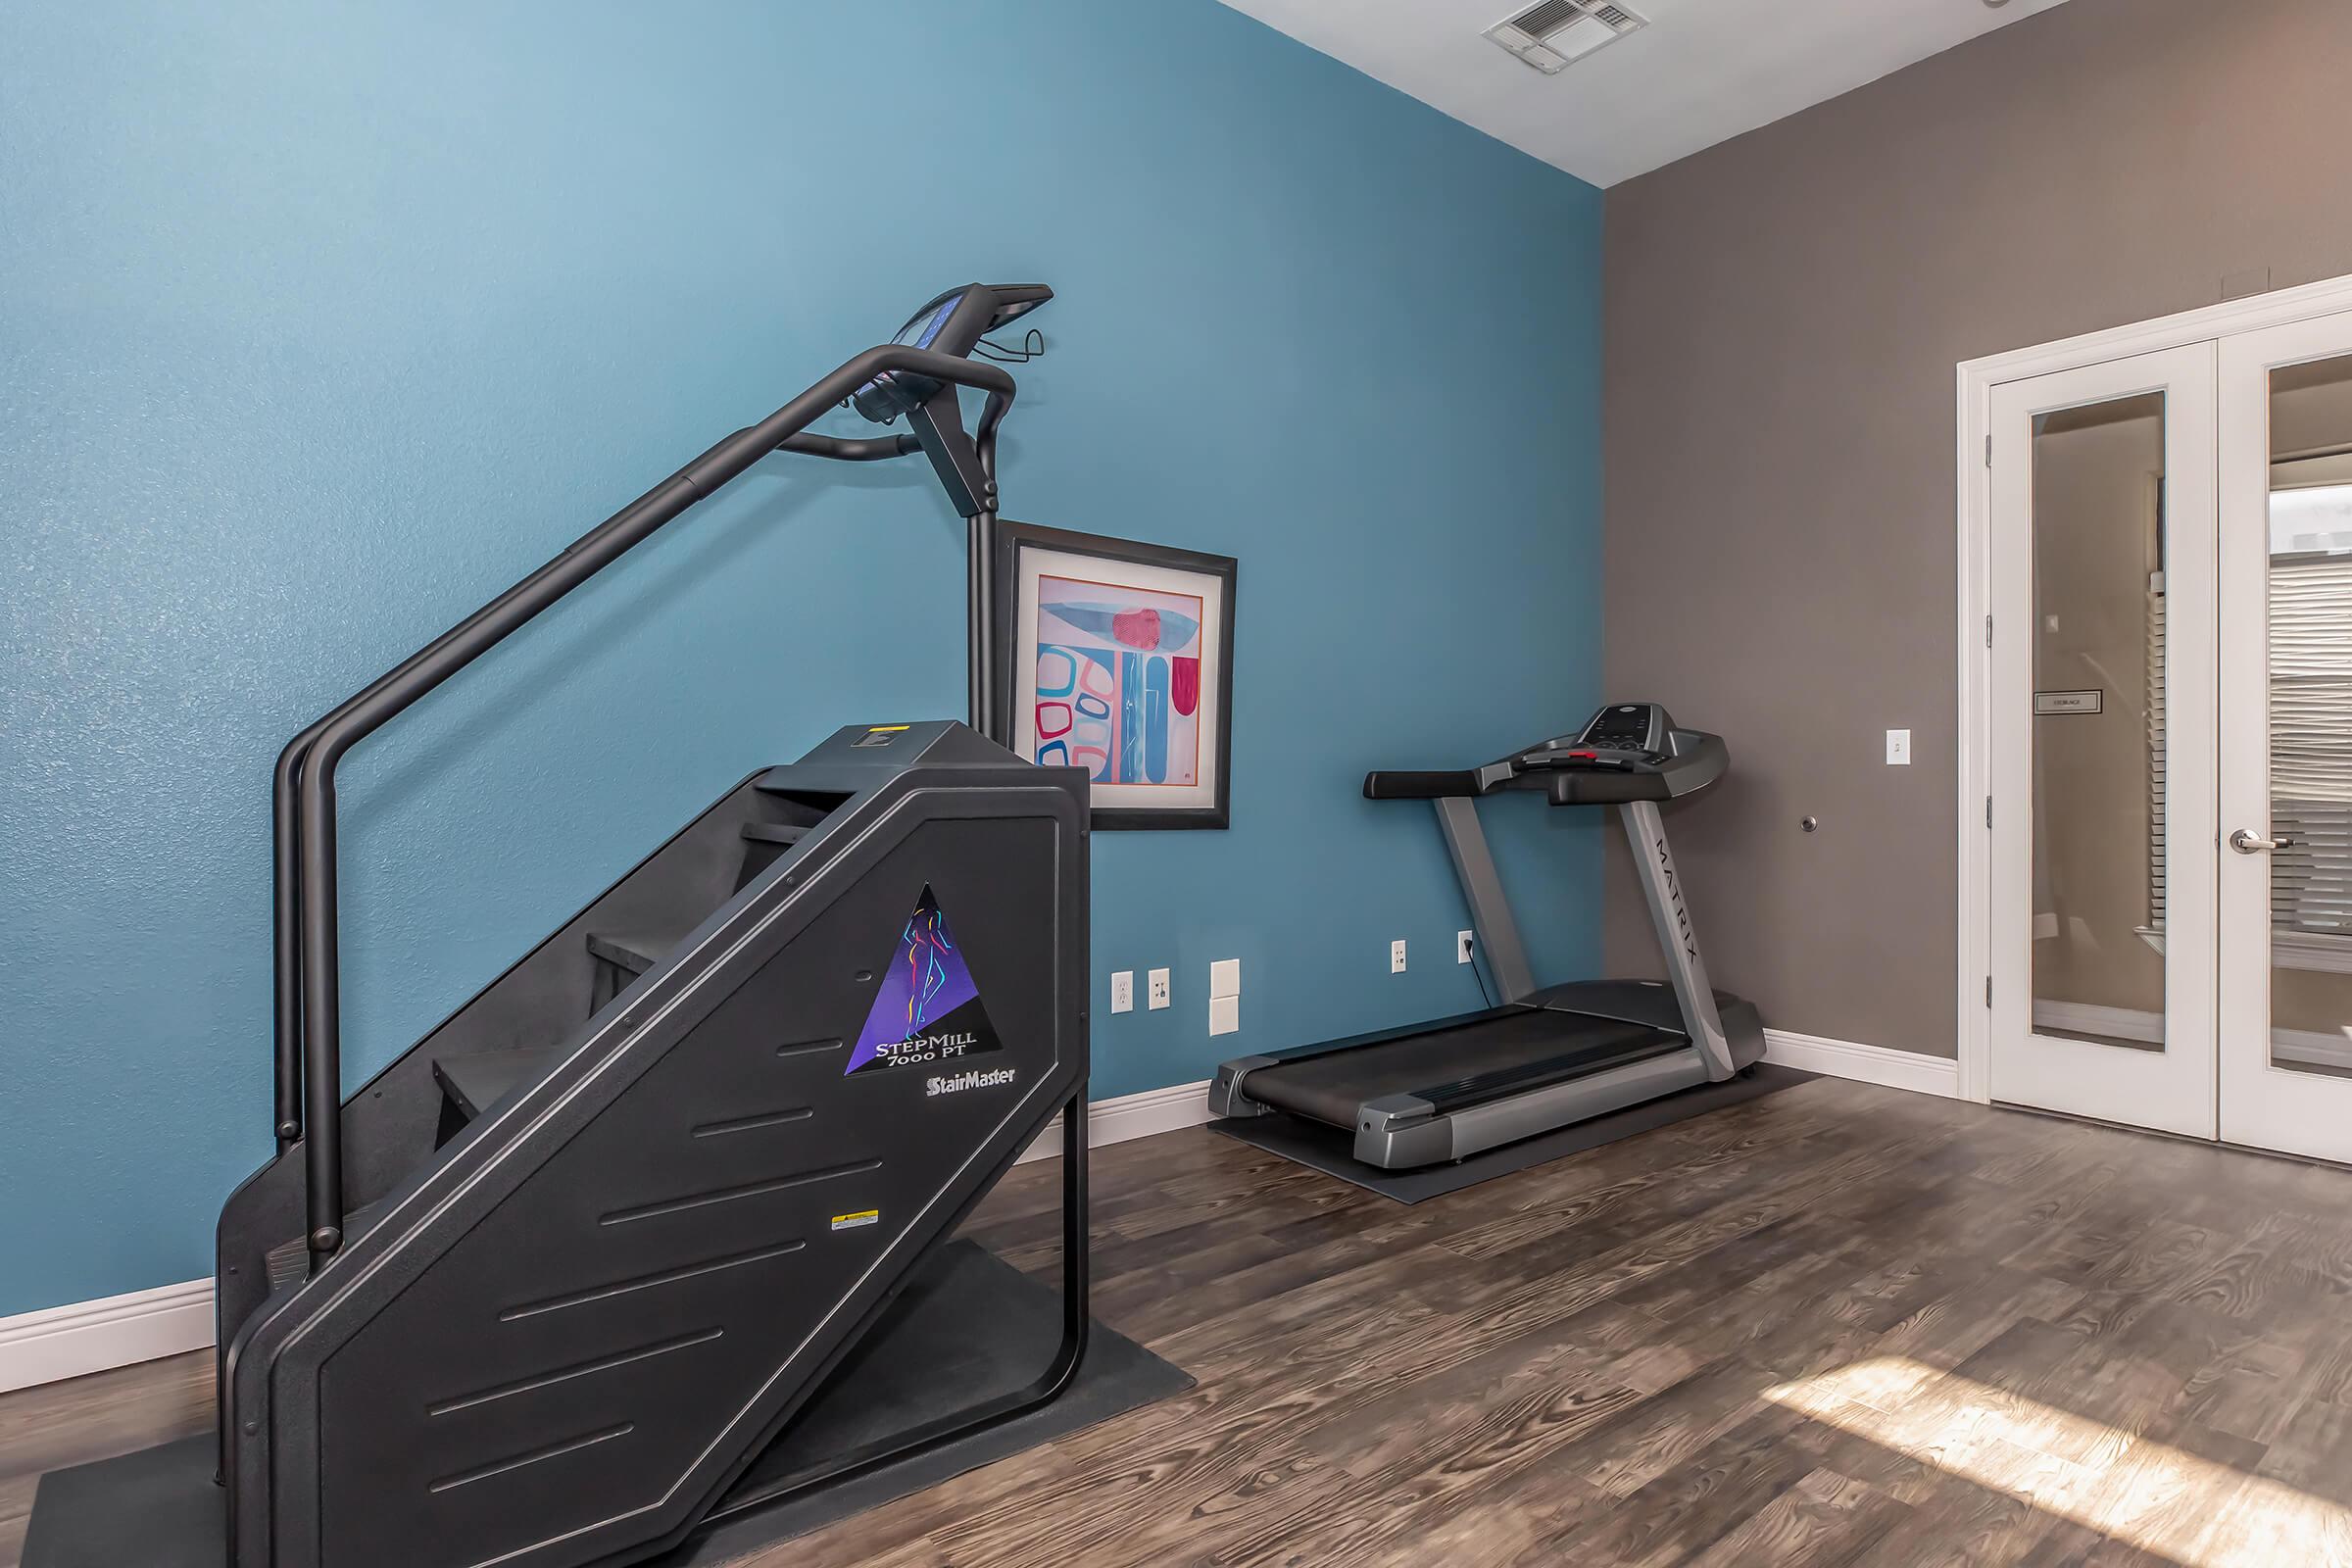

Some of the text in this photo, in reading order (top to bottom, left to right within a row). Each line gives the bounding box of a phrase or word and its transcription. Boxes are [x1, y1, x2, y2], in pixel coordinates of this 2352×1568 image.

[1656, 839, 1696, 964] MATRIX
[887, 1045, 966, 1067] 7000 PT
[926, 1068, 1015, 1097] StairMaster
